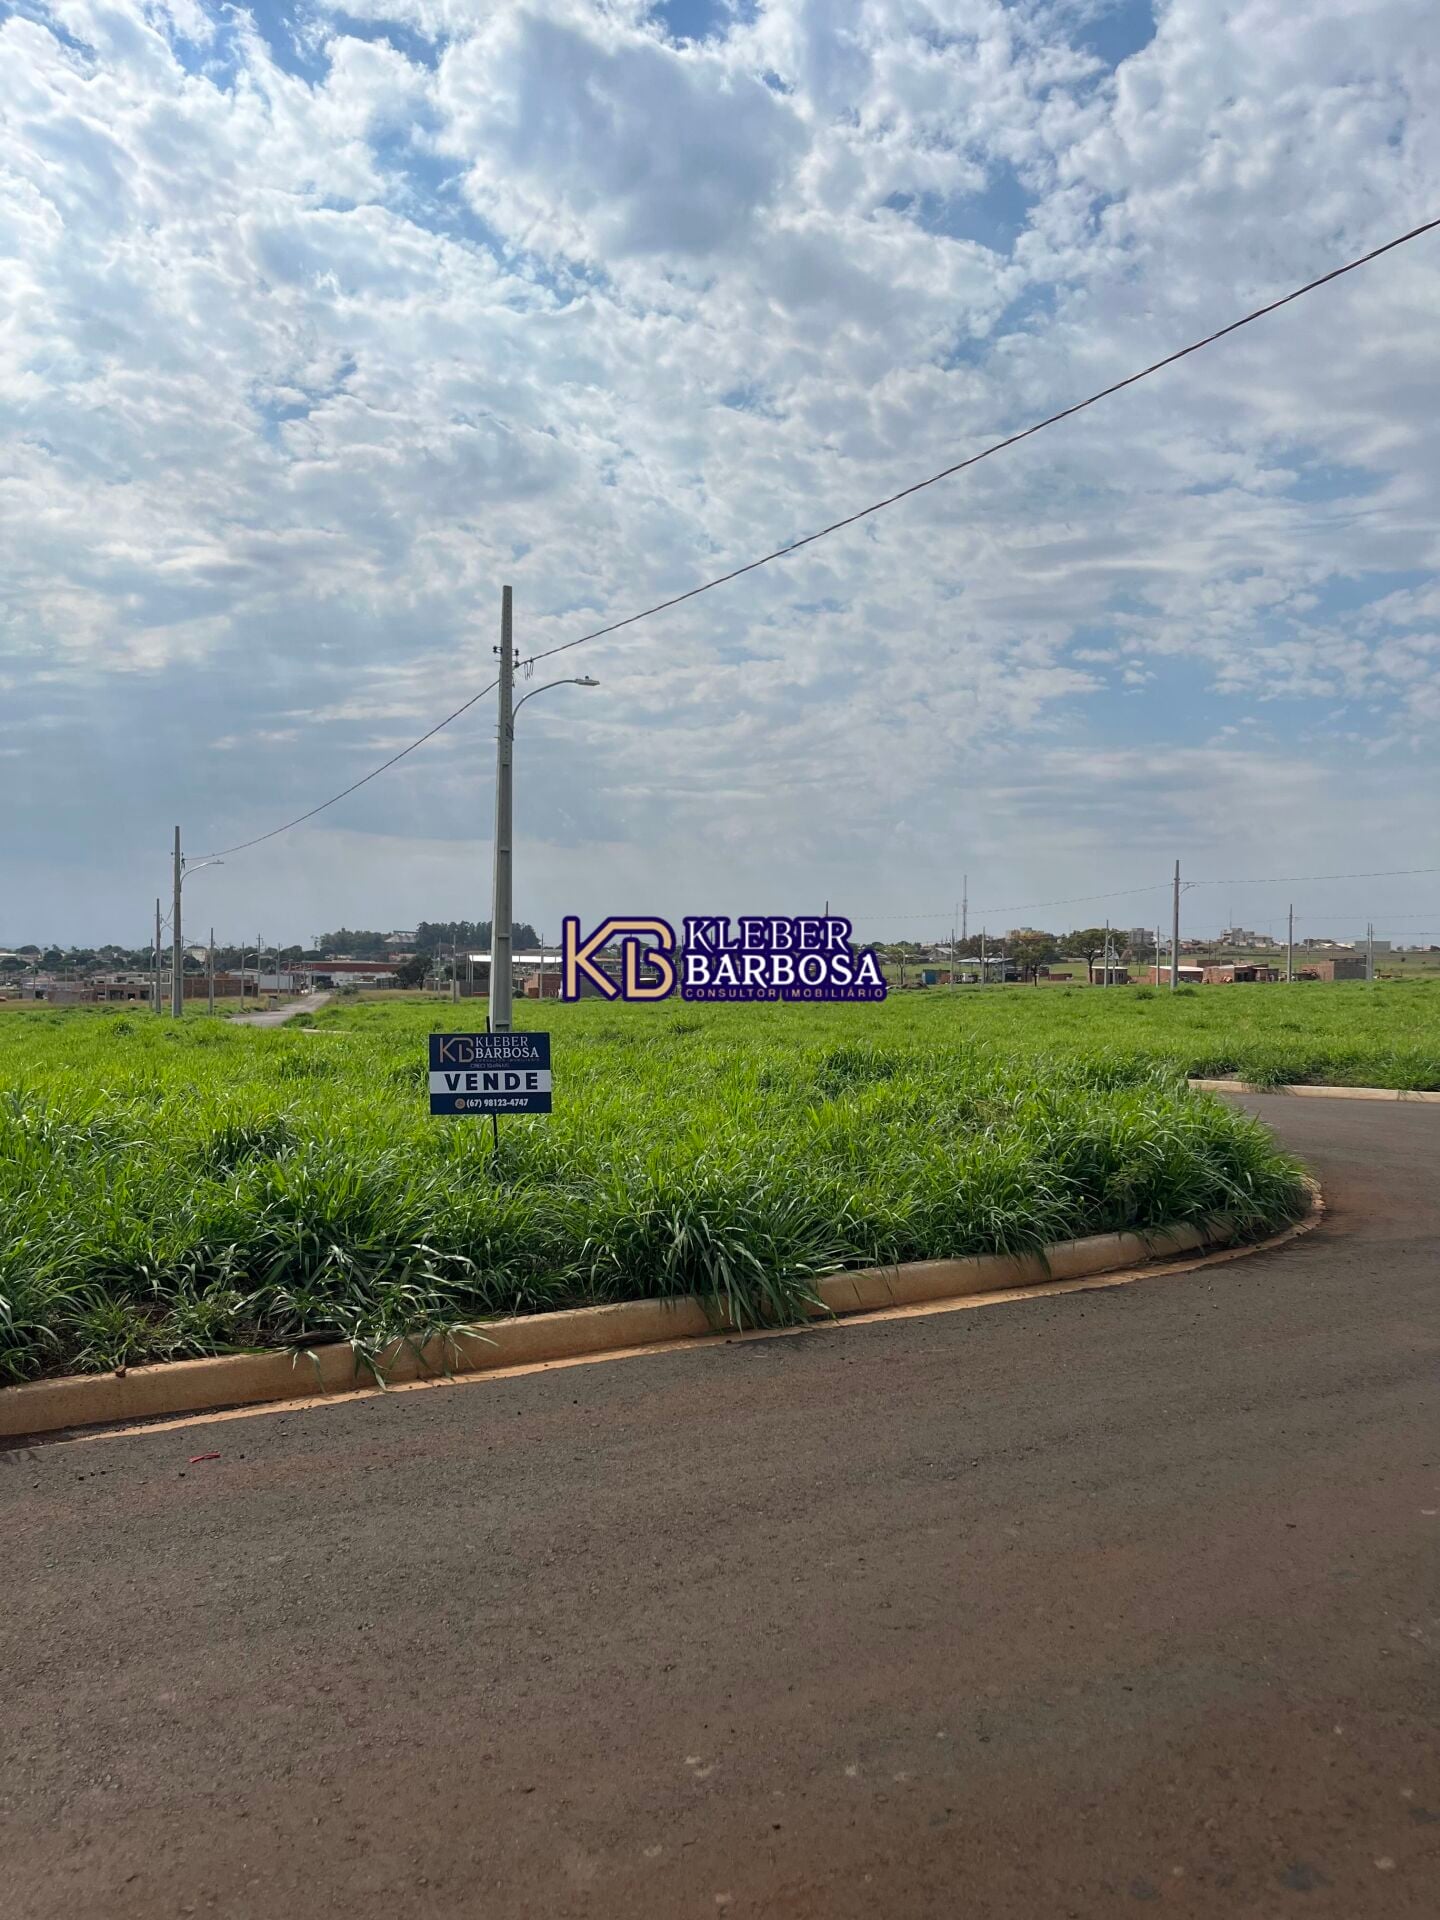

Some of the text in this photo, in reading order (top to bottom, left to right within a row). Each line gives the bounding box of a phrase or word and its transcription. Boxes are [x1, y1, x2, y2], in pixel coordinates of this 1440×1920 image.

[475, 1036, 528, 1047] KLEBER
[475, 1046, 540, 1059] BARBOSA
[444, 1072, 539, 1091] VENDE
[466, 1098, 529, 1108] (67) 98123-4747
